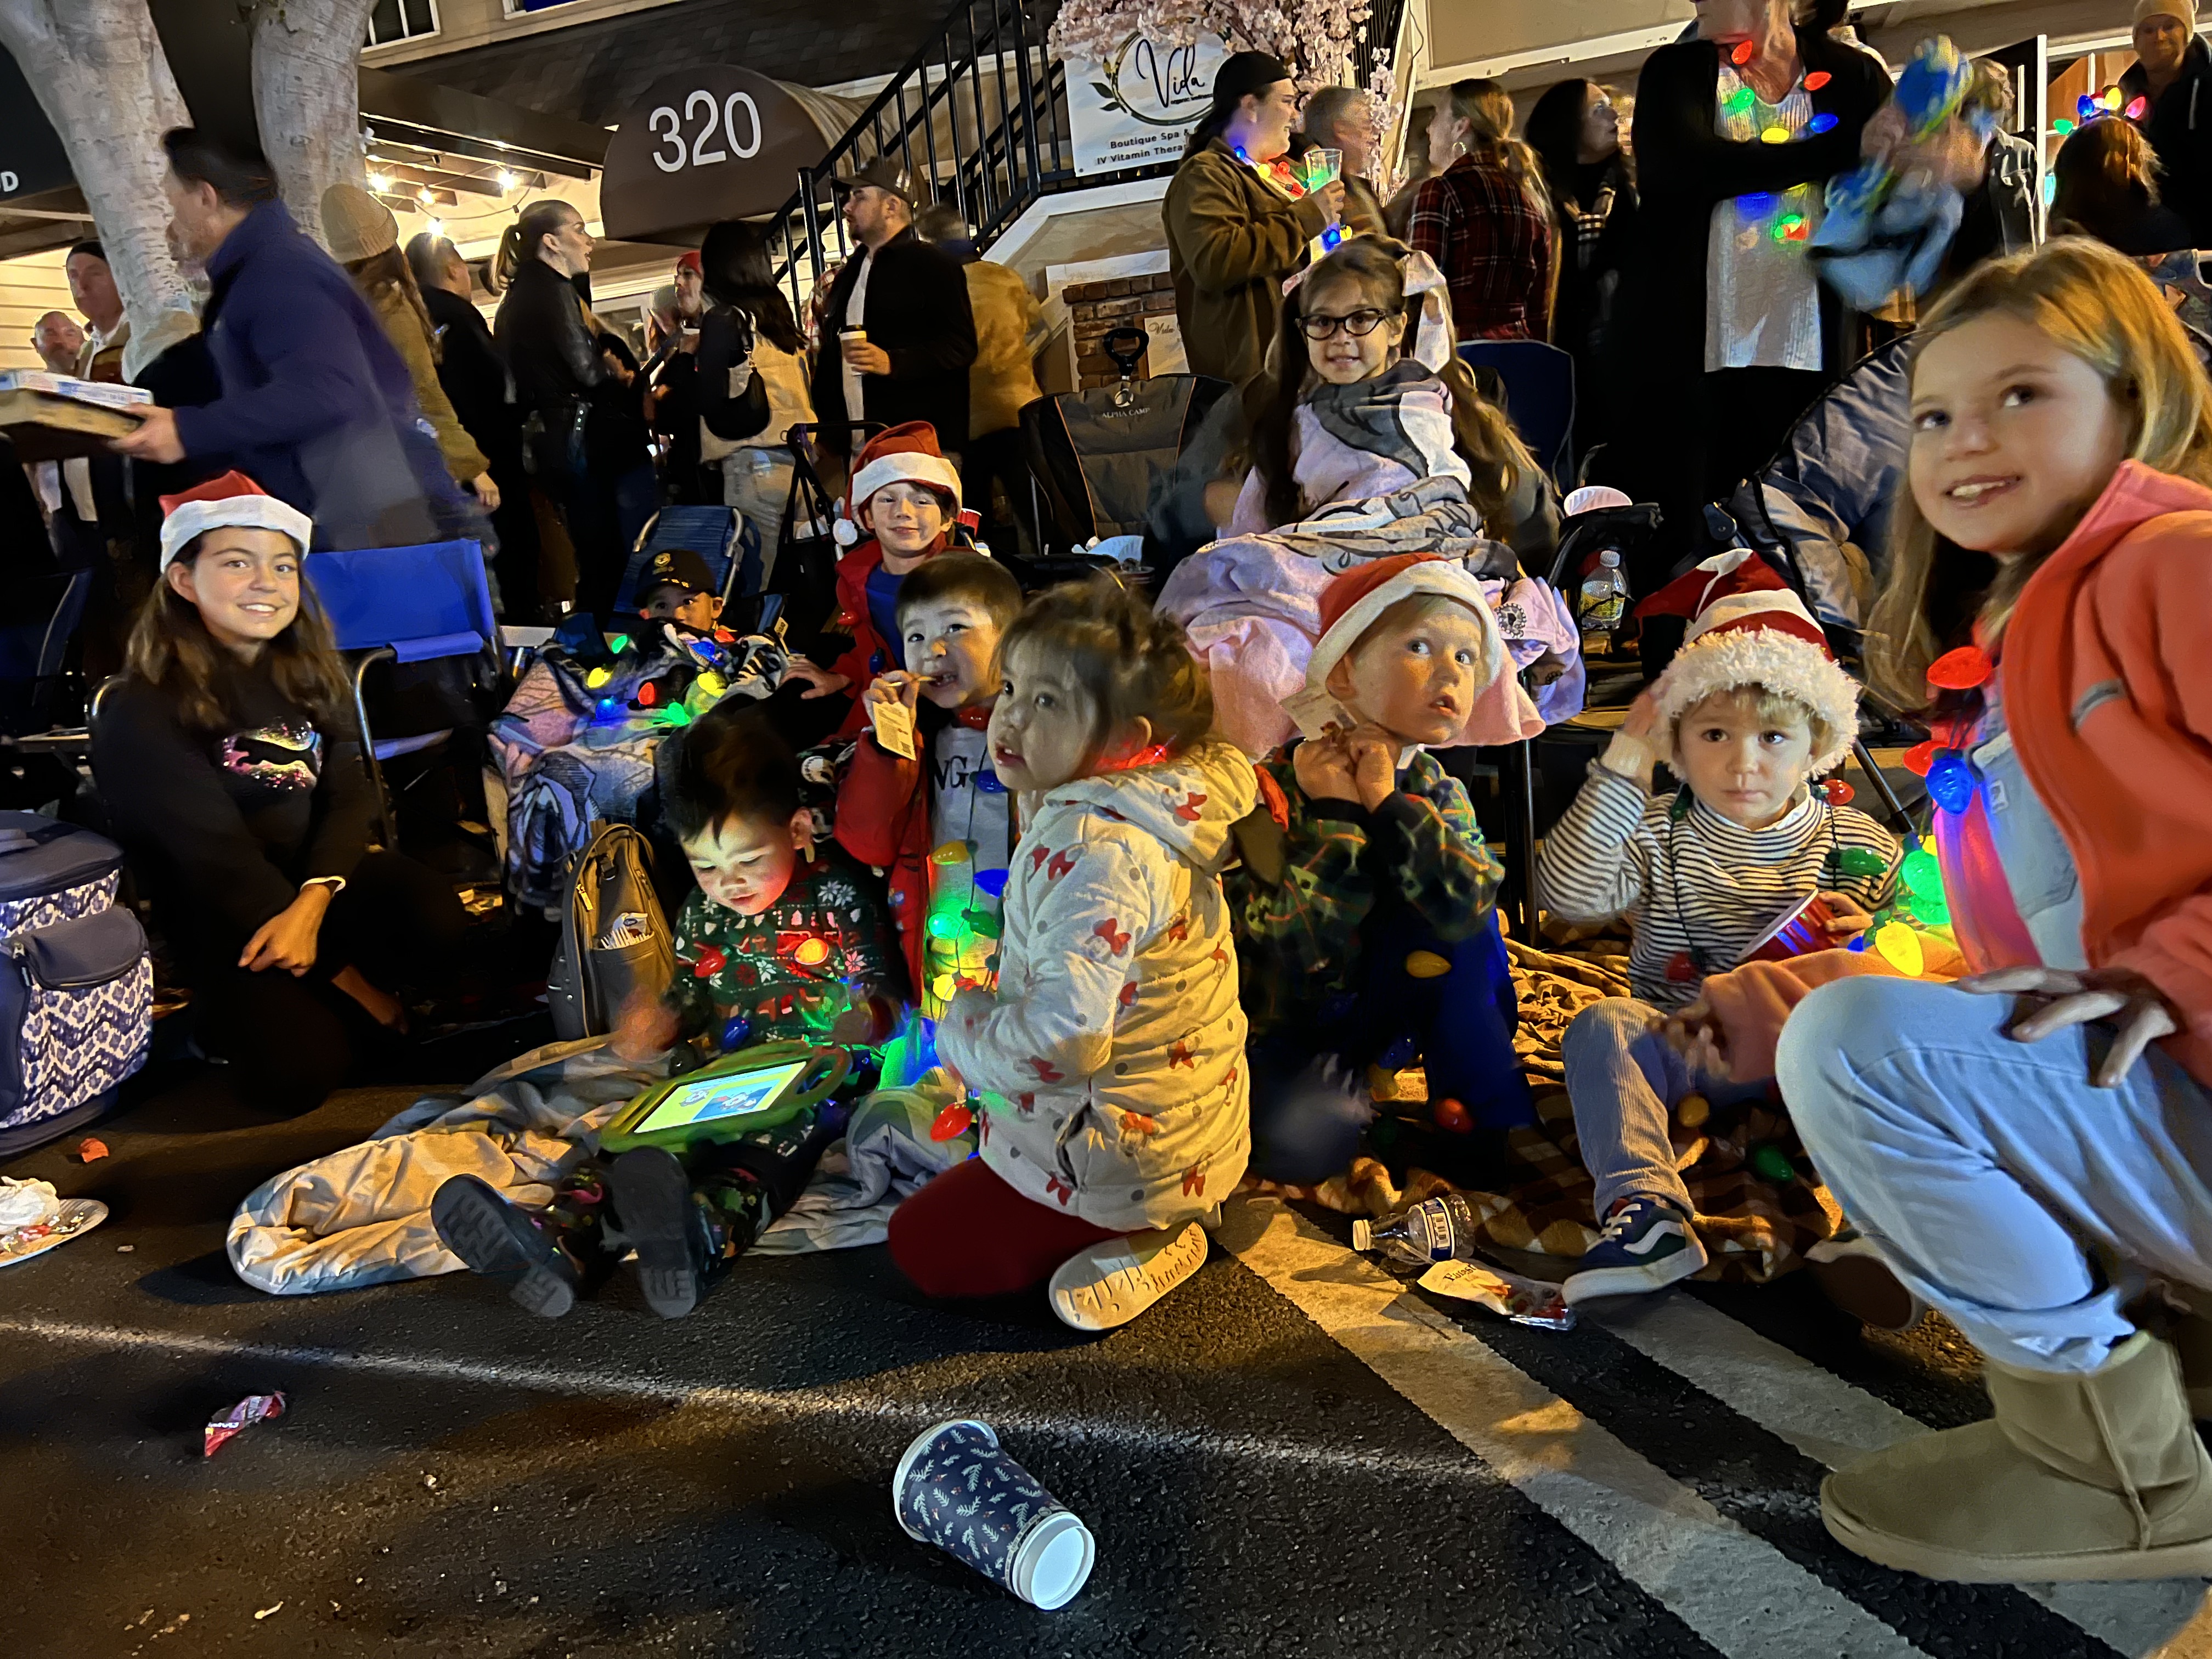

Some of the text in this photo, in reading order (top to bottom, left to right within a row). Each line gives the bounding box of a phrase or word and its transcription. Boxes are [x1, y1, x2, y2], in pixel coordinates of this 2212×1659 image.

[1136, 38, 1206, 108] Vida
[649, 89, 761, 172] 320
[1110, 136, 1157, 149] Boutique
[1161, 132, 1180, 141] Spa
[1097, 144, 1187, 165] IV Vitamin Thera
[1128, 408, 1150, 416] CAMP
